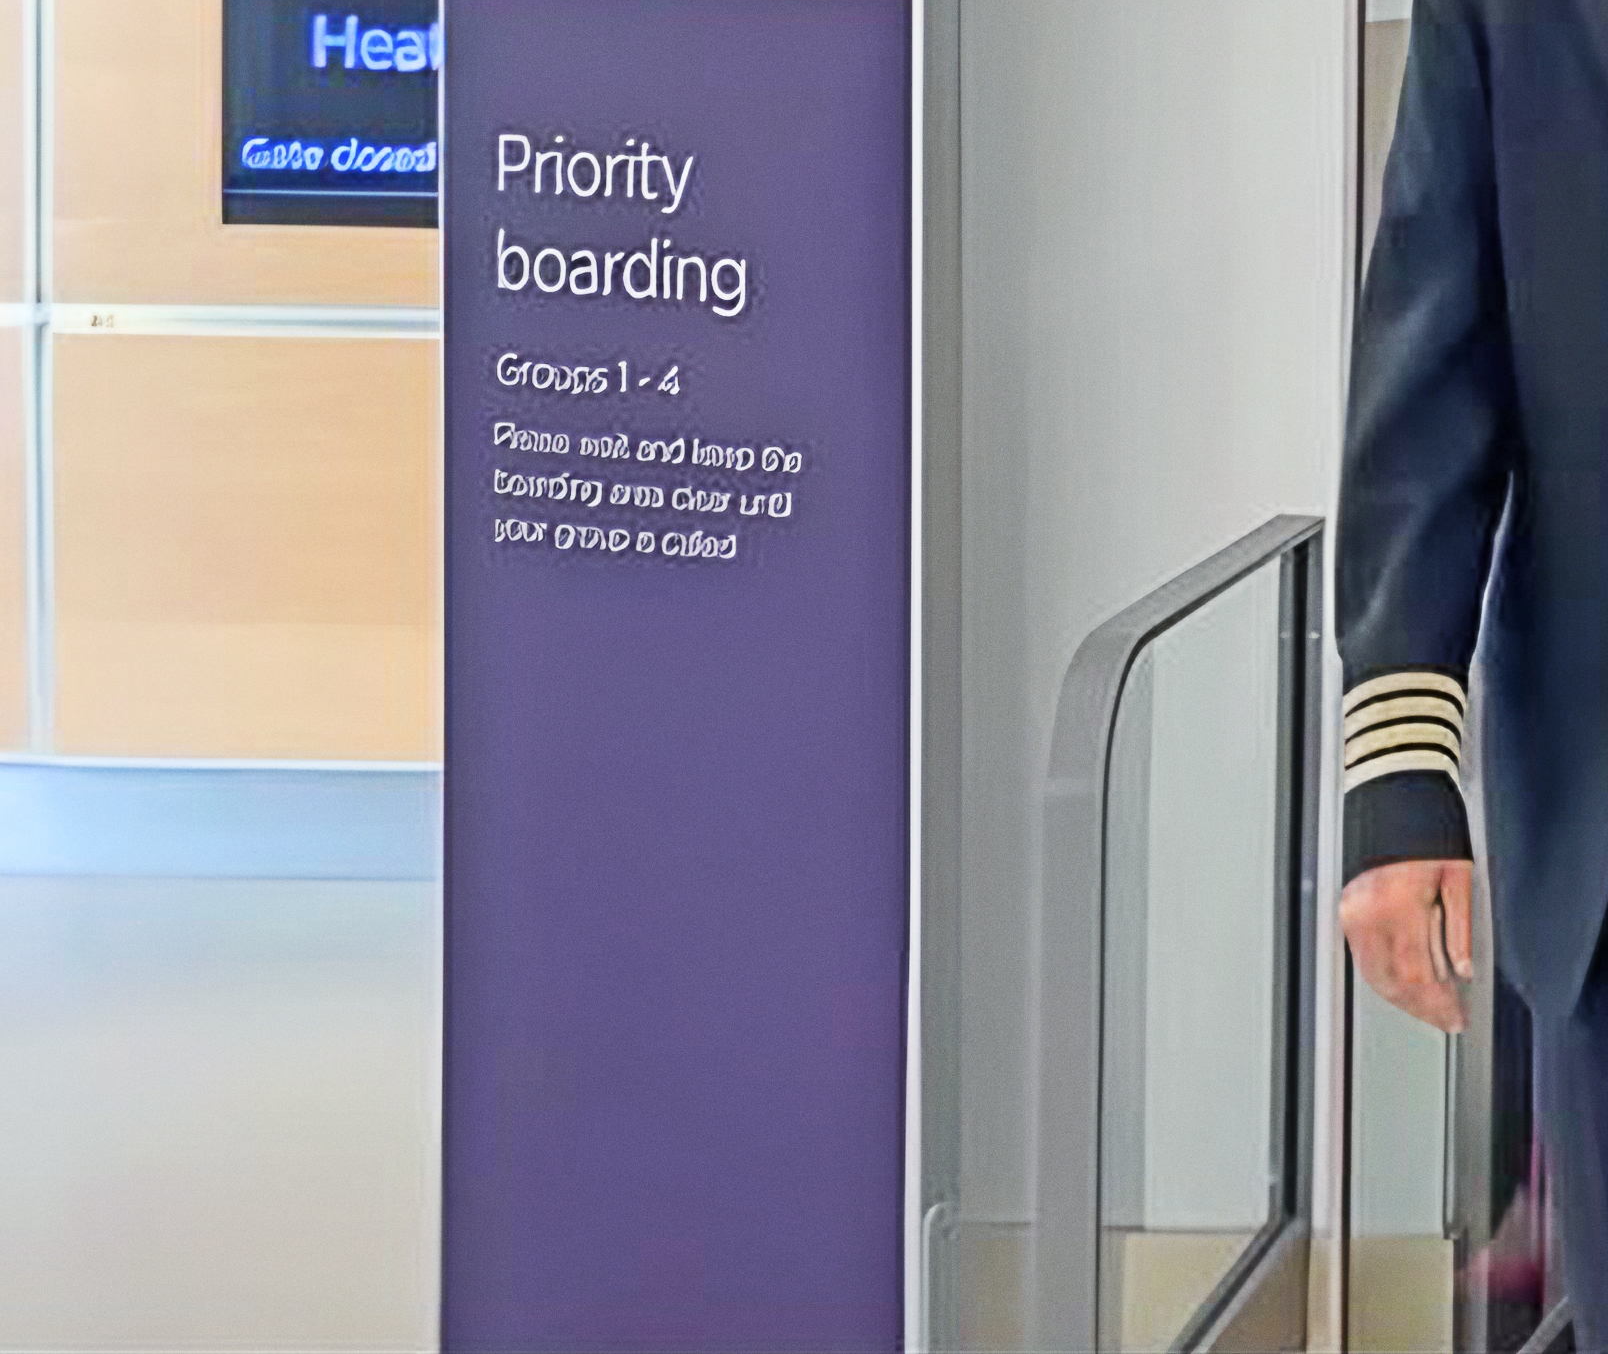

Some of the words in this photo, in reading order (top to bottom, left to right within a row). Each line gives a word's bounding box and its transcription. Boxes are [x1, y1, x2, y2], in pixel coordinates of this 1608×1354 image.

[497, 133, 694, 214] Priority
[496, 228, 747, 317] boarding
[616, 360, 629, 393] 1
